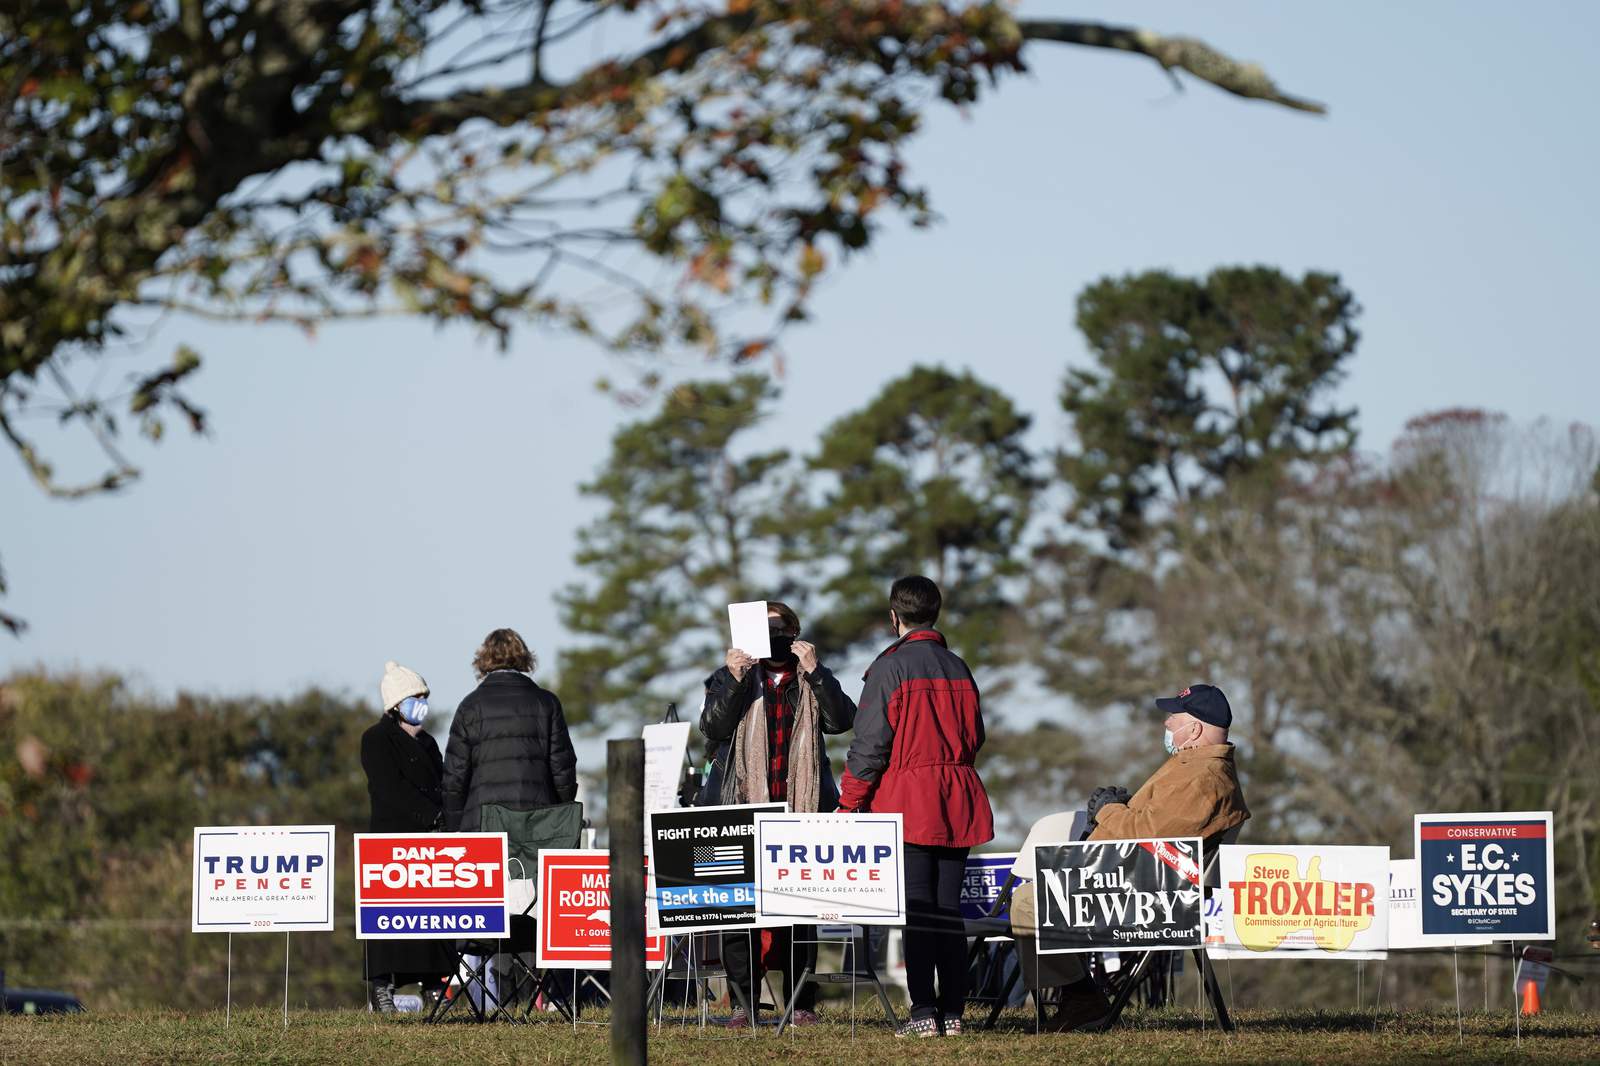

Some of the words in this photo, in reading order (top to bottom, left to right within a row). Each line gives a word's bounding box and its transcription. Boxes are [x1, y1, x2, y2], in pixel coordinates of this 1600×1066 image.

[657, 828, 691, 840] FIGHT
[694, 827, 718, 839] FOR
[1447, 828, 1517, 837] CONSERVATIVE
[392, 847, 435, 861] DAN
[766, 845, 892, 863] TRUMP
[1461, 843, 1510, 871] E.C.
[204, 855, 324, 874] TRUMP
[1253, 866, 1290, 879] Steve
[362, 862, 500, 889] FOREST
[778, 869, 880, 881] PENCE
[1078, 866, 1126, 890] Paul
[214, 877, 312, 890] PENCE
[1432, 873, 1536, 906] SYKES
[661, 889, 698, 906] Back
[702, 887, 729, 904] the
[1040, 868, 1181, 928] NEWBY
[1229, 881, 1375, 916] TROXLER
[1451, 908, 1487, 916] SECRETARY
[376, 914, 487, 930] GOVERNOR
[1245, 917, 1301, 927] Commissioner
[1304, 917, 1312, 927] of
[1313, 917, 1358, 928] Agriculture
[1112, 929, 1160, 943] Supreme
[1162, 927, 1195, 938] Court
